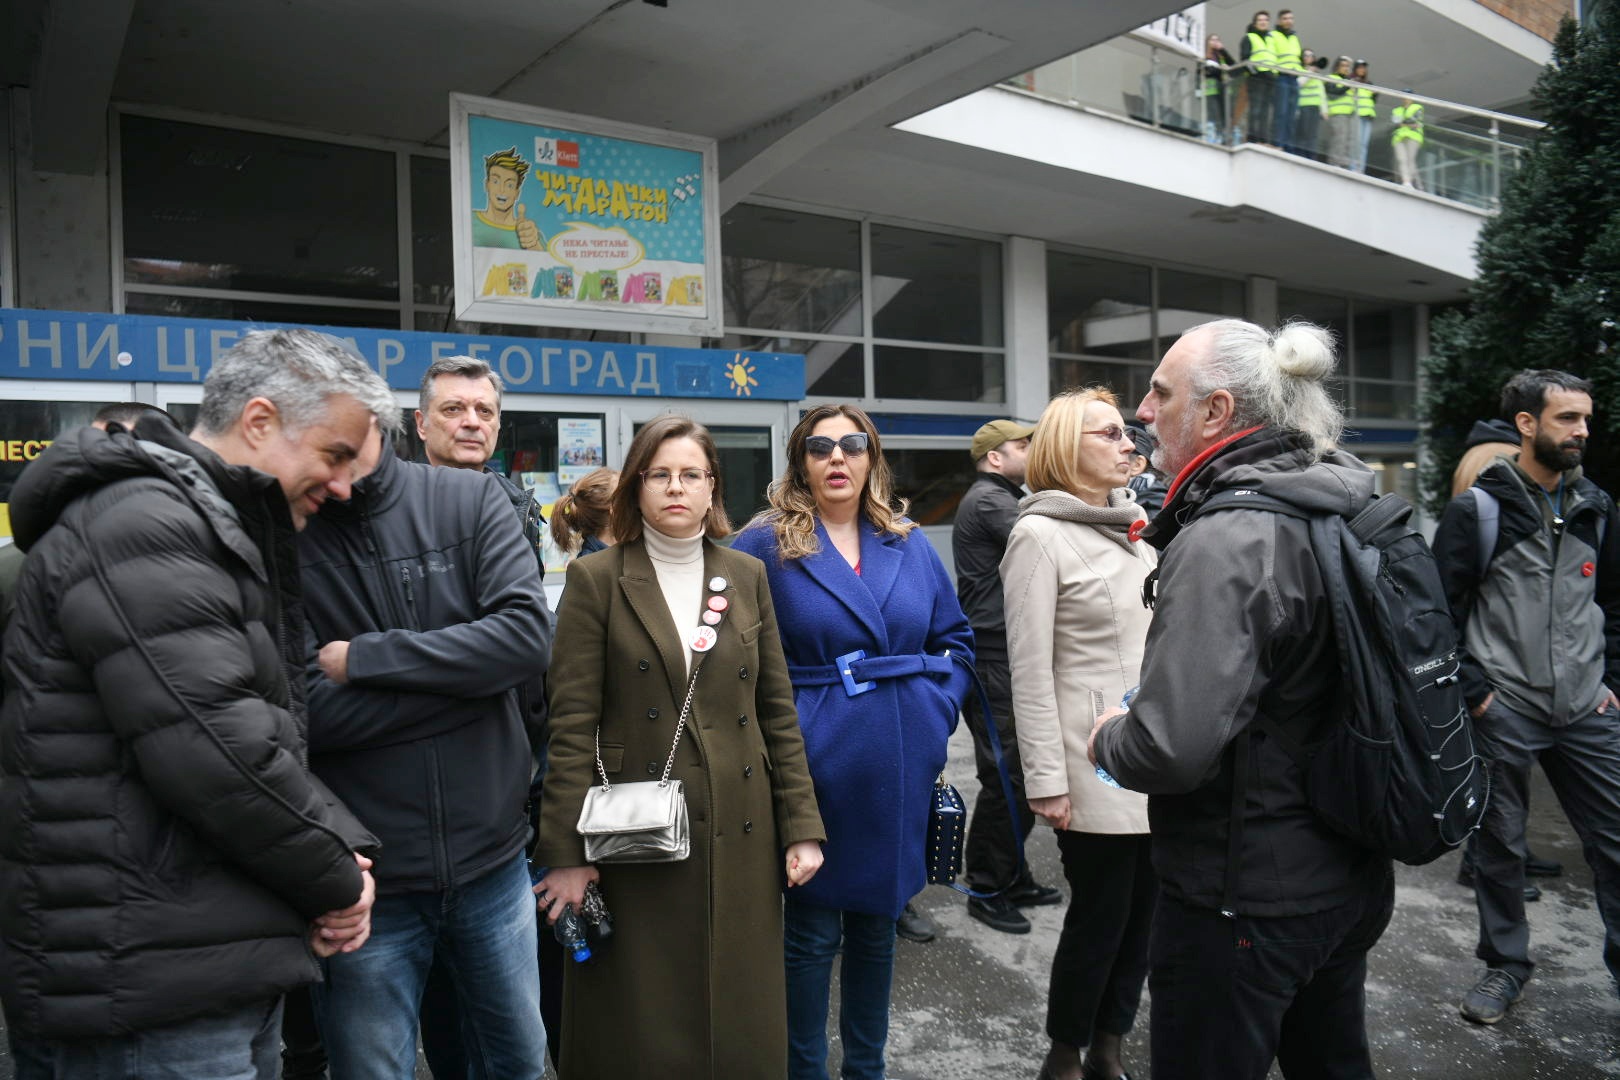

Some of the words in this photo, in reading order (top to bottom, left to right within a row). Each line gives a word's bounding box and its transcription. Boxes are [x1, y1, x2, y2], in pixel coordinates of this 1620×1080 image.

[535, 169, 668, 212] ЧИТАЛАЧКИ
[541, 178, 668, 223] МАРАТОН
[563, 239, 588, 248] НЕКА
[590, 239, 629, 248] ЧИТАЊЕ
[565, 250, 578, 259] НЕ
[580, 250, 629, 259] ПРЕСТАЈЕ!
[0, 319, 119, 370] НИ
